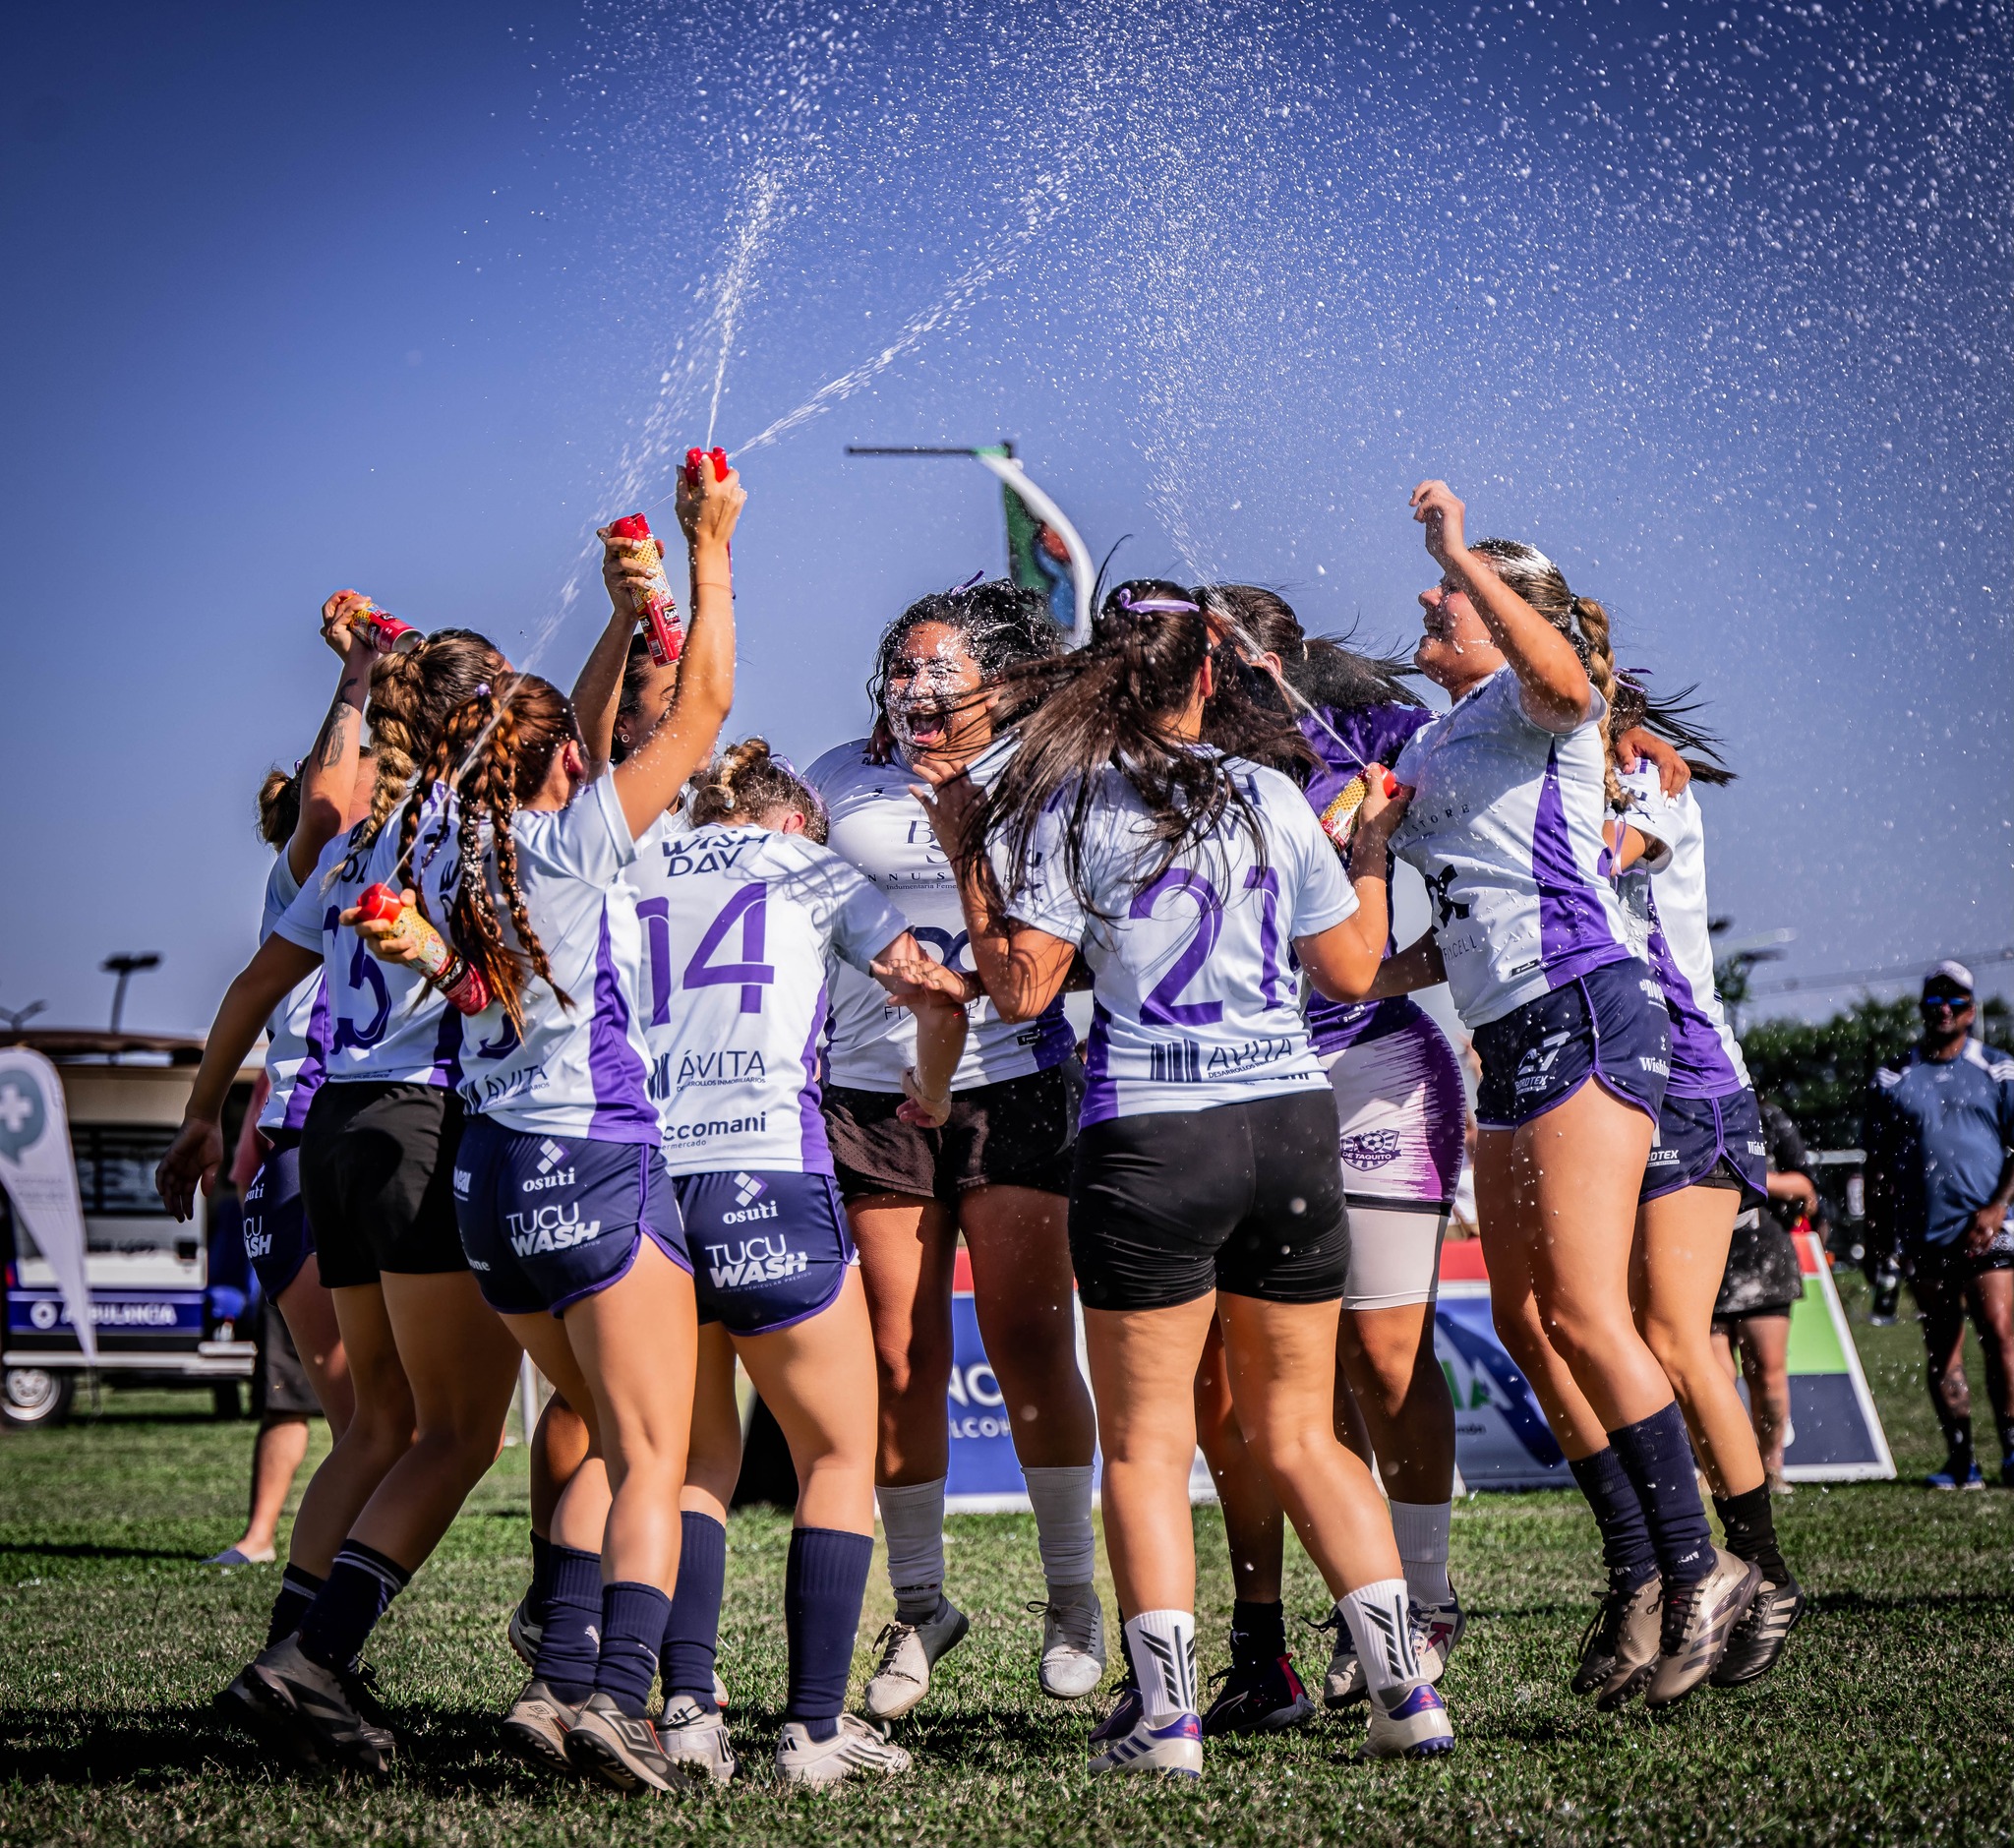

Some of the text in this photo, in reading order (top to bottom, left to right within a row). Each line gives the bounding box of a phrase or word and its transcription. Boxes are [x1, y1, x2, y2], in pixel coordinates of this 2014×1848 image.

[667, 846, 744, 877] DAY
[635, 881, 775, 1027] 14
[1129, 865, 1284, 1026] 21
[677, 1049, 766, 1084] ÁVITA
[1208, 1063, 1256, 1079] DESARROLLOS
[663, 1110, 766, 1142] ccomani
[661, 1139, 707, 1151] ermercado
[244, 1182, 266, 1203] suti
[522, 1166, 576, 1193] osuti
[244, 1215, 263, 1239] CU
[505, 1202, 580, 1236] TUCU
[723, 1200, 779, 1224] osuti
[244, 1233, 273, 1259] ASH
[510, 1221, 601, 1258] WASH
[704, 1233, 787, 1268] TUCU
[709, 1251, 808, 1288] WASH
